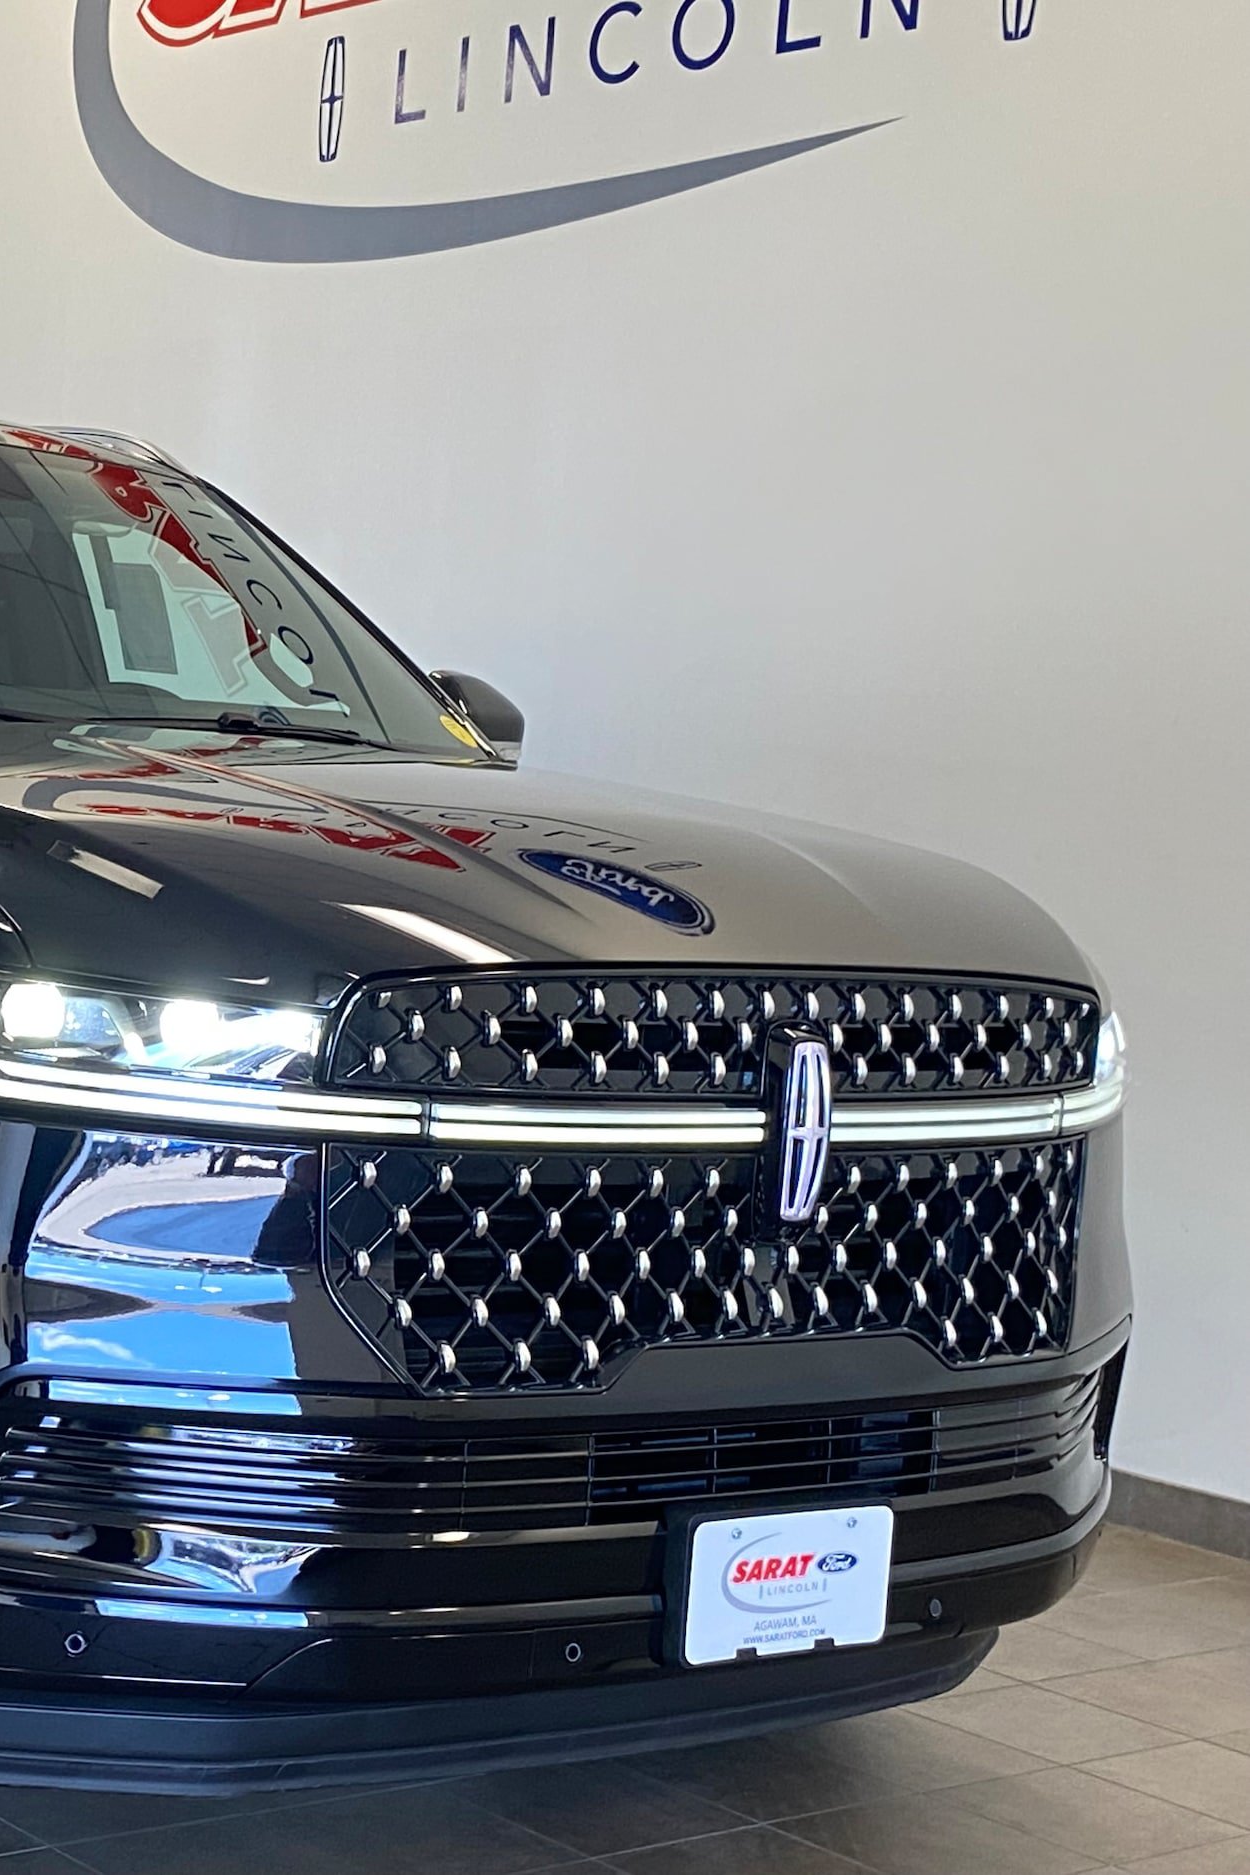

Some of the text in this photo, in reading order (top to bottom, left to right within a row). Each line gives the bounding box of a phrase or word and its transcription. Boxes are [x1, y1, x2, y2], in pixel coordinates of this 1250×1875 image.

[731, 1554, 815, 1584] SARAT
[768, 1582, 818, 1597] LINCOLN
[753, 1615, 818, 1632] AGAWAM, MA
